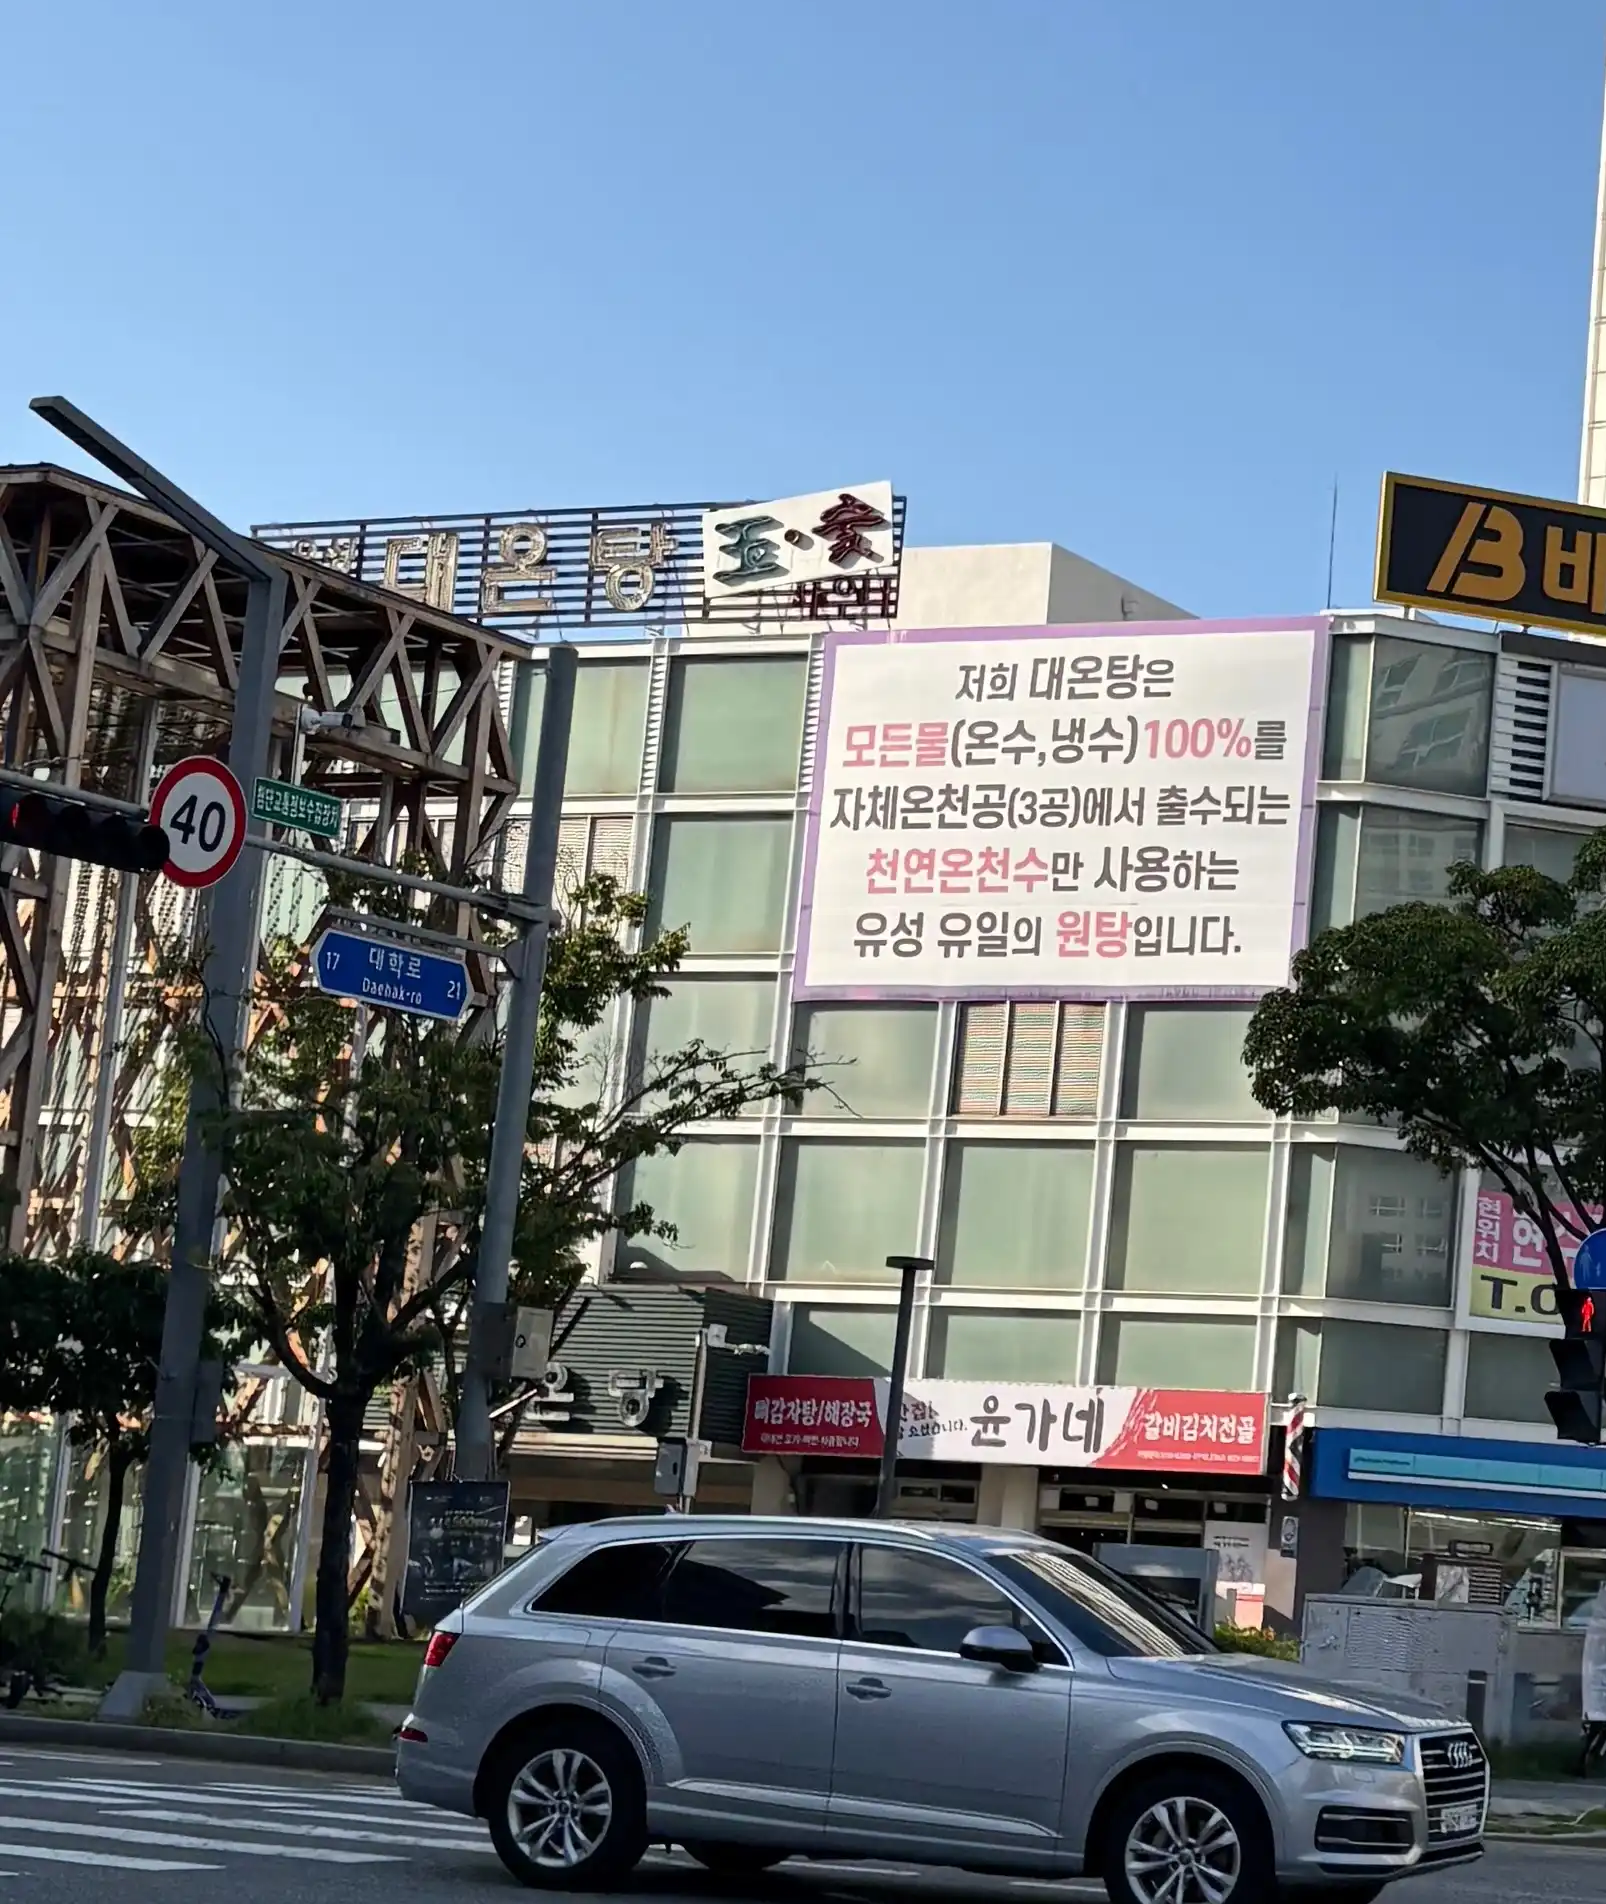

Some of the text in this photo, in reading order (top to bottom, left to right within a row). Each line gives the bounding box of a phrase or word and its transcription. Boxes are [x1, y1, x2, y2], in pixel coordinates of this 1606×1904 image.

[955, 654, 1175, 702] 저희 대온탕은
[170, 794, 226, 853] 40
[829, 783, 1290, 831] 자체온천공(3공)에서 출수되는
[866, 845, 1240, 895] 천연온천수만 사용하는
[853, 910, 1241, 958] 유성 유일의 원탕입니다.
[326, 951, 341, 971] 17
[369, 947, 421, 979] 대학로
[362, 977, 422, 1005] Daehak-ro
[447, 980, 461, 1000] 21
[969, 1395, 1105, 1454] 윤가네
[1144, 1411, 1257, 1445] 갈비김치전골
